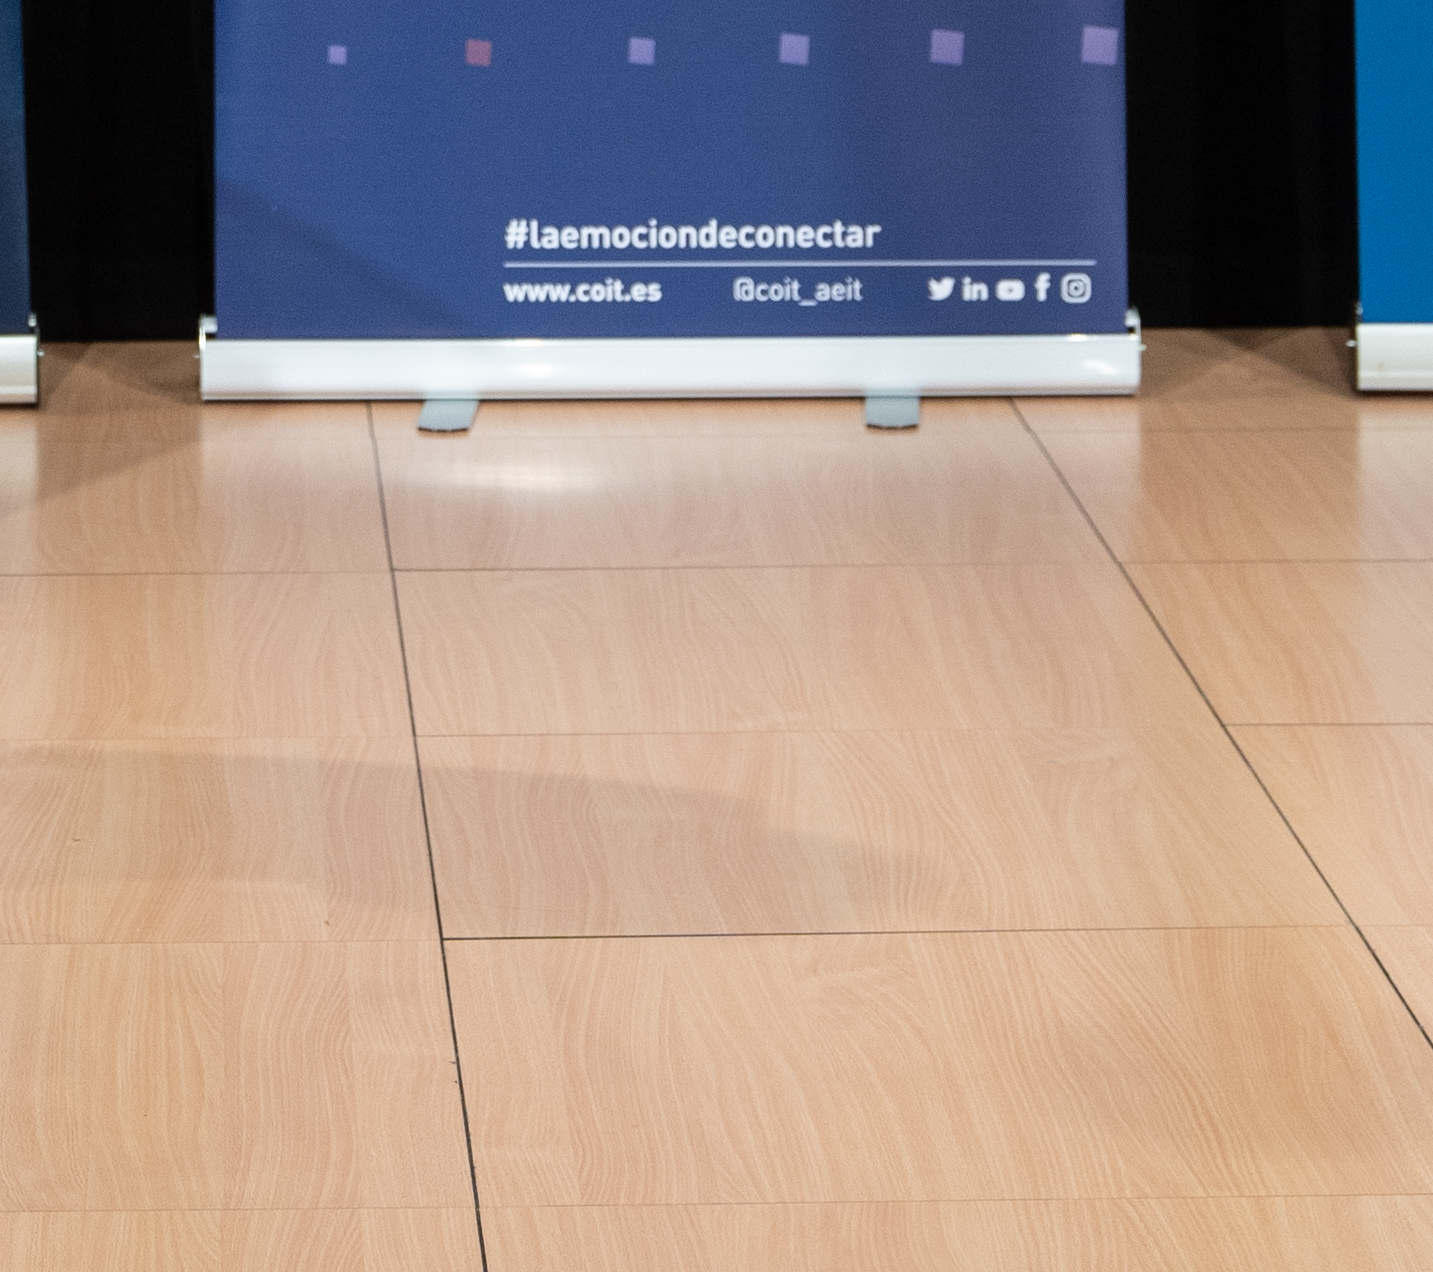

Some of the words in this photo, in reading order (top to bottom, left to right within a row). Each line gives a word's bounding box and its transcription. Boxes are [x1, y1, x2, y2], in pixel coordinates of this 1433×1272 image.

[505, 218, 881, 250] #laemociondeconectar
[504, 278, 662, 304] www.coit.es
[732, 276, 863, 306] @coit_aeit
